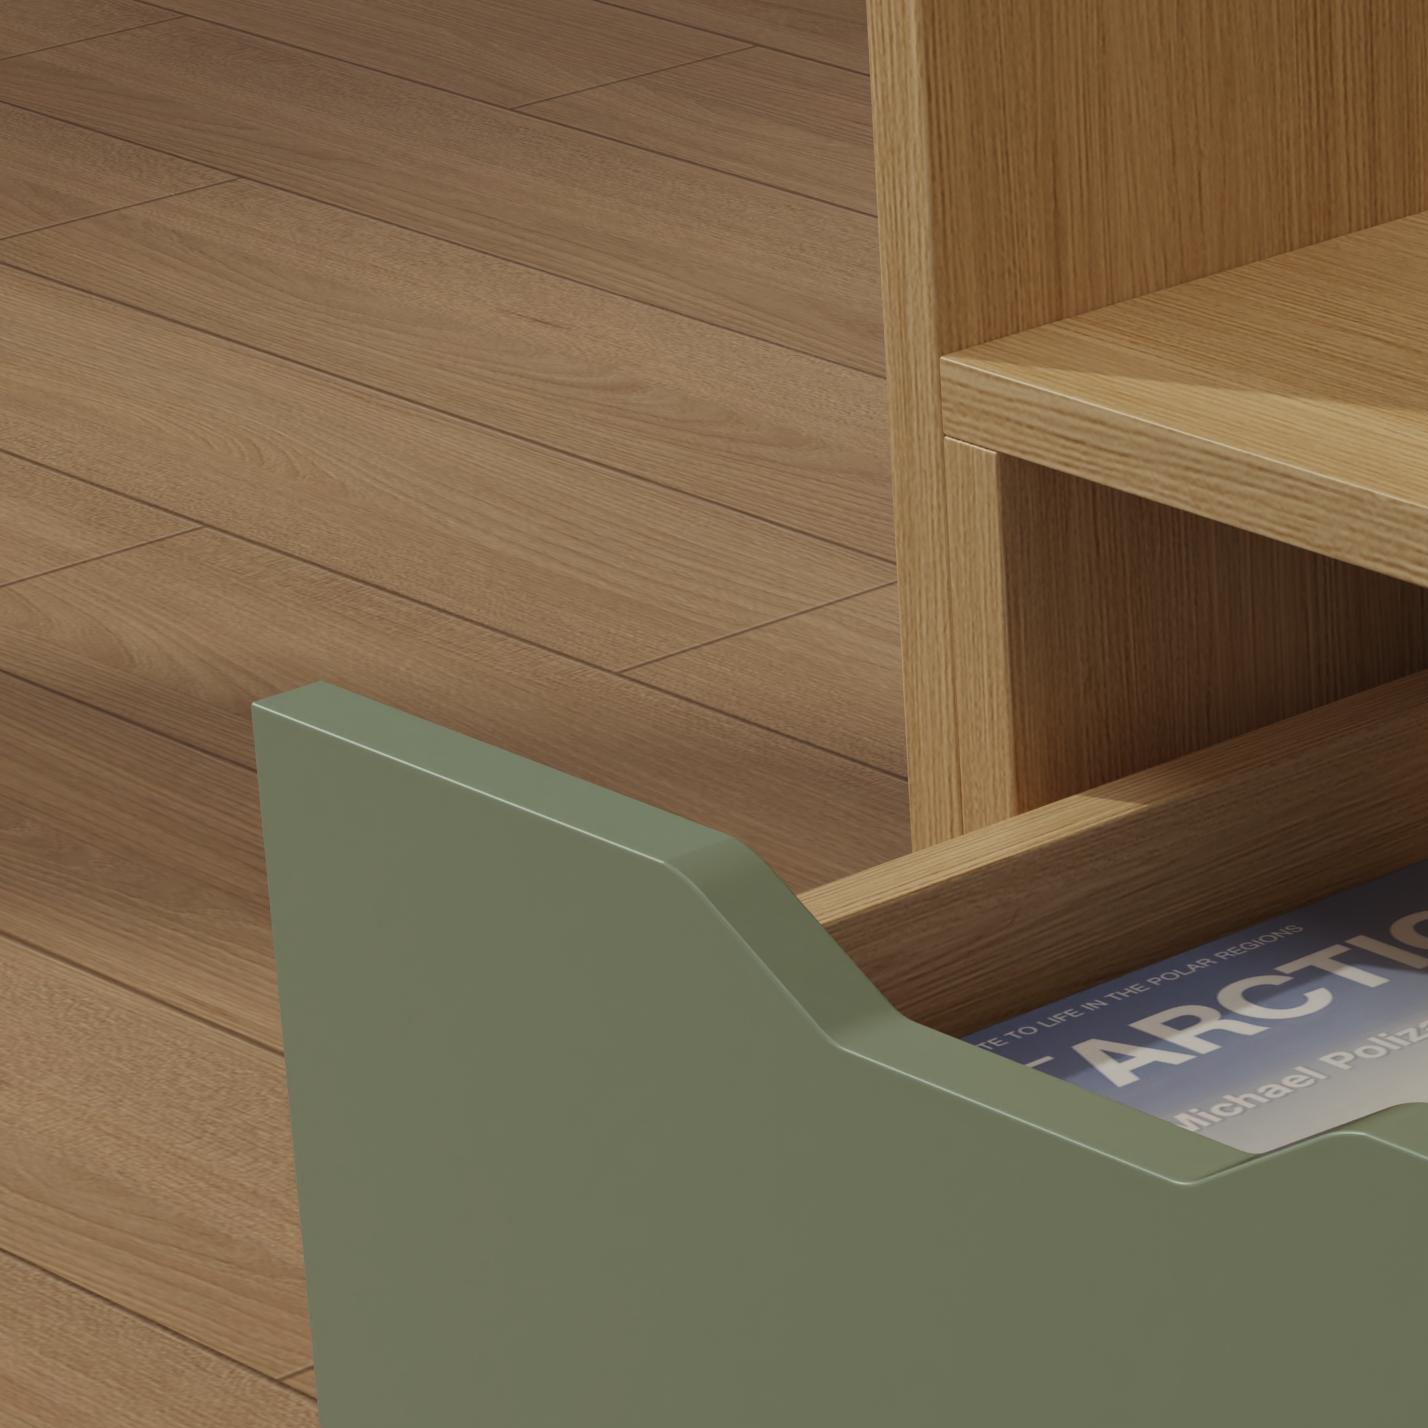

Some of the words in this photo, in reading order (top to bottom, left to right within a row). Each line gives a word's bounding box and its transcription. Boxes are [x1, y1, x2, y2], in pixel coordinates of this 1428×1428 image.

[1004, 1026, 1038, 1039] TO
[1036, 1008, 1085, 1028] LIFE
[1081, 999, 1109, 1012] IN
[1104, 983, 1151, 1001] THE
[1147, 958, 1217, 987] POLAR
[1213, 924, 1304, 960] REGIONS
